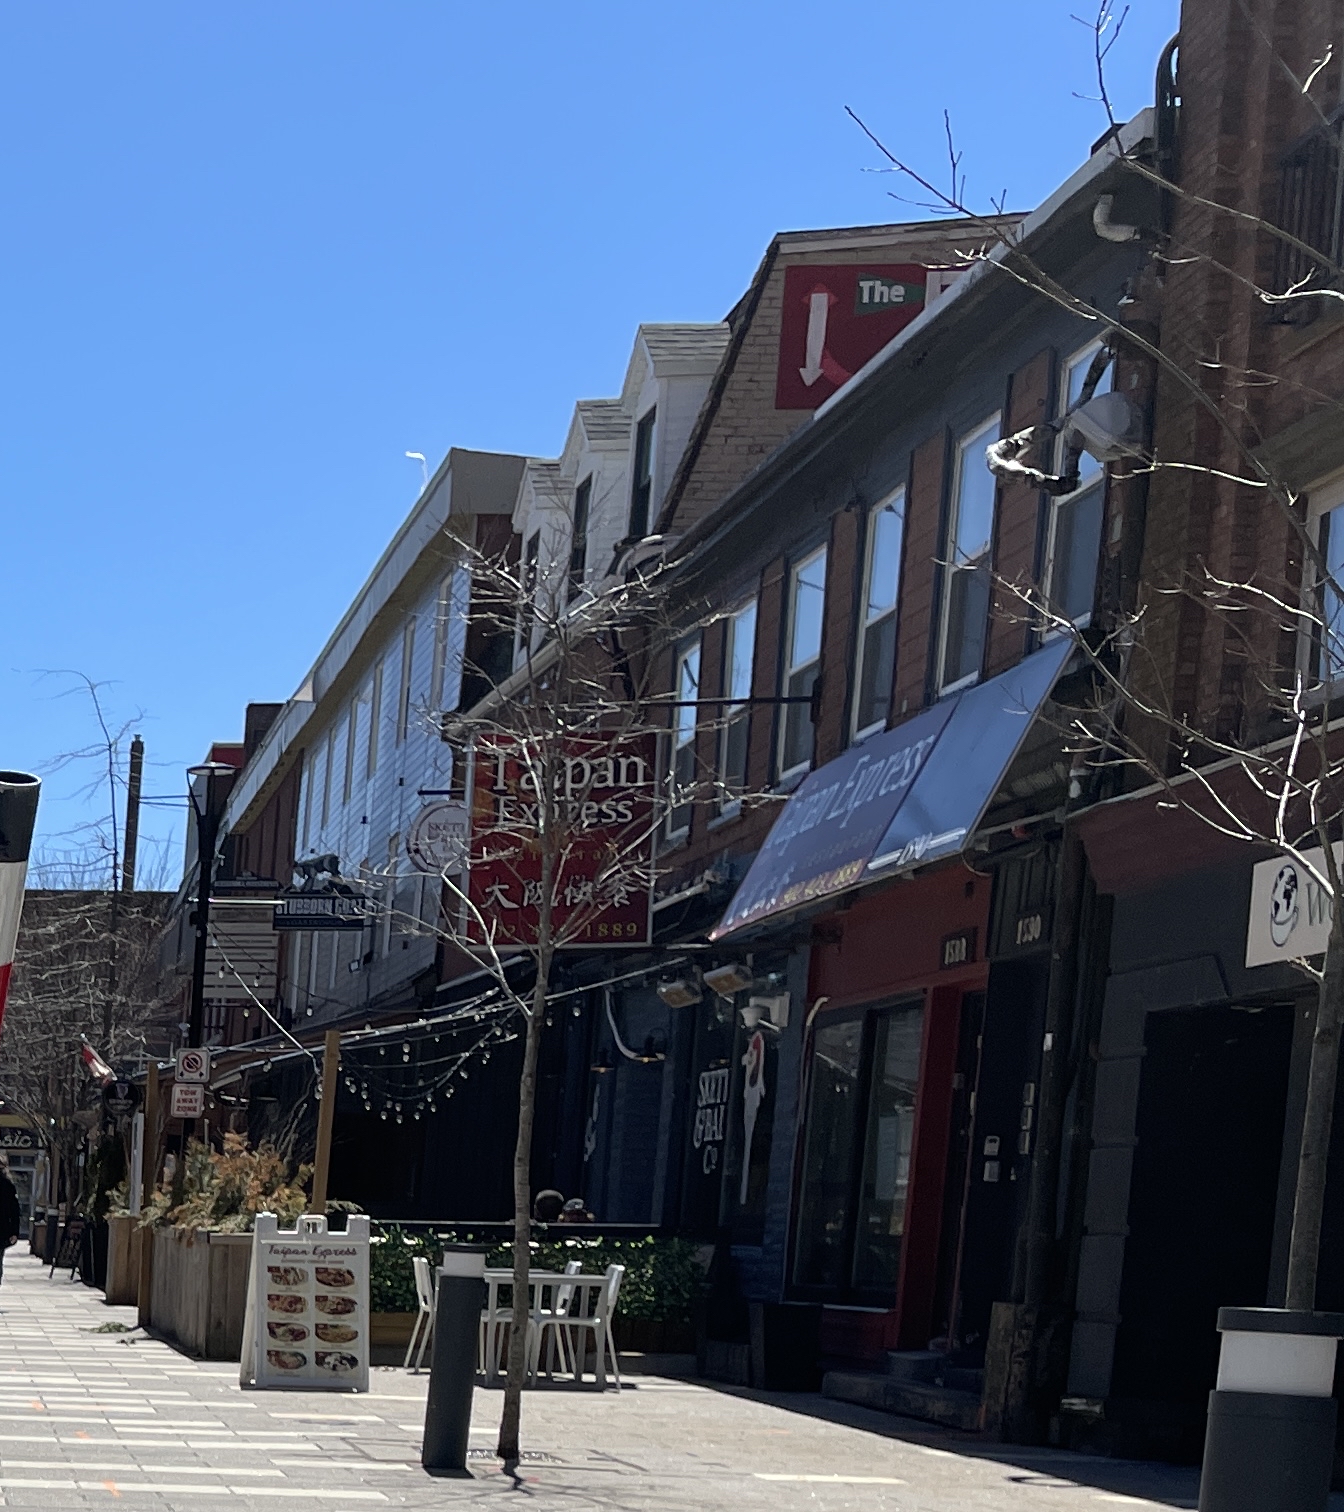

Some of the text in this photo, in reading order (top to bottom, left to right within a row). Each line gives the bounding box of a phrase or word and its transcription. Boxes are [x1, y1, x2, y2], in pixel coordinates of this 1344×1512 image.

[859, 280, 905, 303] The
[497, 795, 633, 826] Exress
[584, 922, 639, 938] 1889
